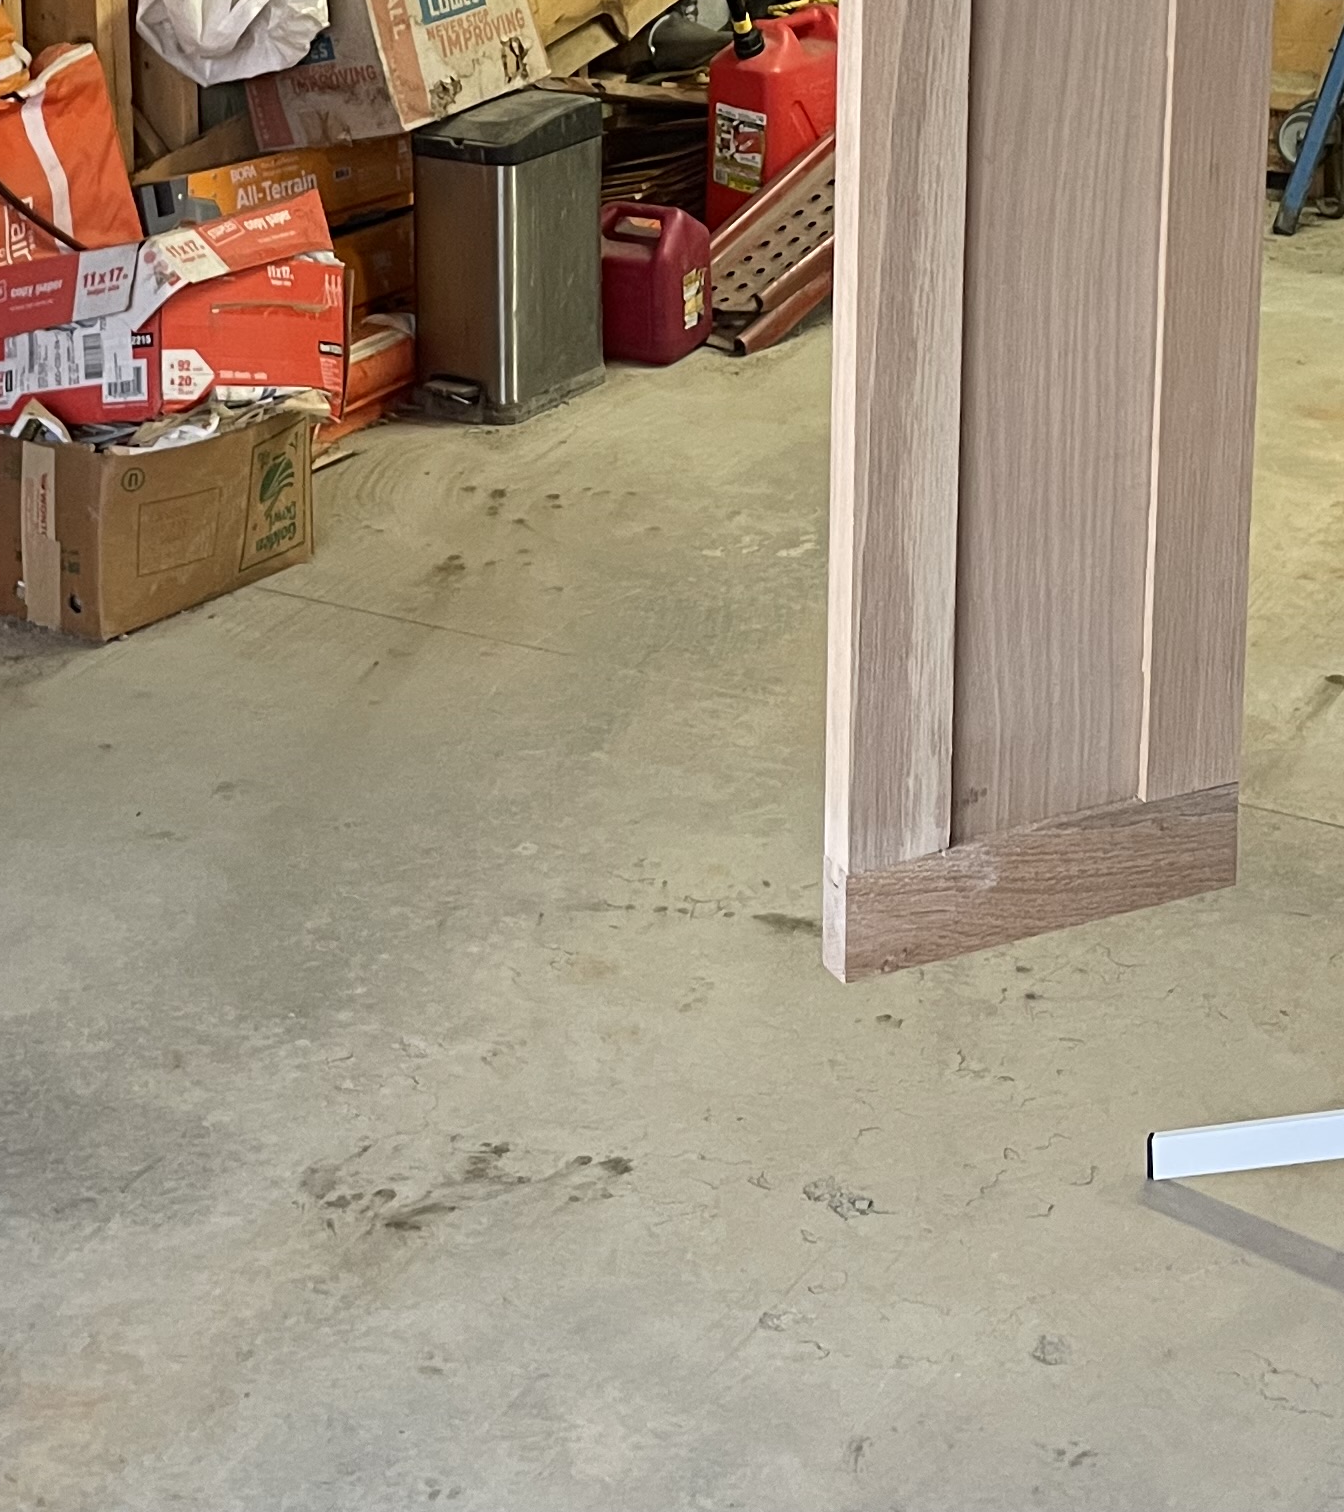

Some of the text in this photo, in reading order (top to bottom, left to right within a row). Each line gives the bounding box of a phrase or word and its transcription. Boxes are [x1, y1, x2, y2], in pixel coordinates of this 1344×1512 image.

[425, 8, 491, 42] NEVER STOP
[439, 8, 526, 59] IMPROVING
[289, 64, 378, 96] IMPROVING
[230, 165, 257, 185] BORA
[236, 169, 318, 210] All-Terrain
[244, 216, 266, 231] copy
[265, 209, 293, 227] paper
[10, 284, 35, 299] copy
[35, 279, 64, 297] paper
[178, 360, 191, 372] 92
[178, 376, 192, 387] 20
